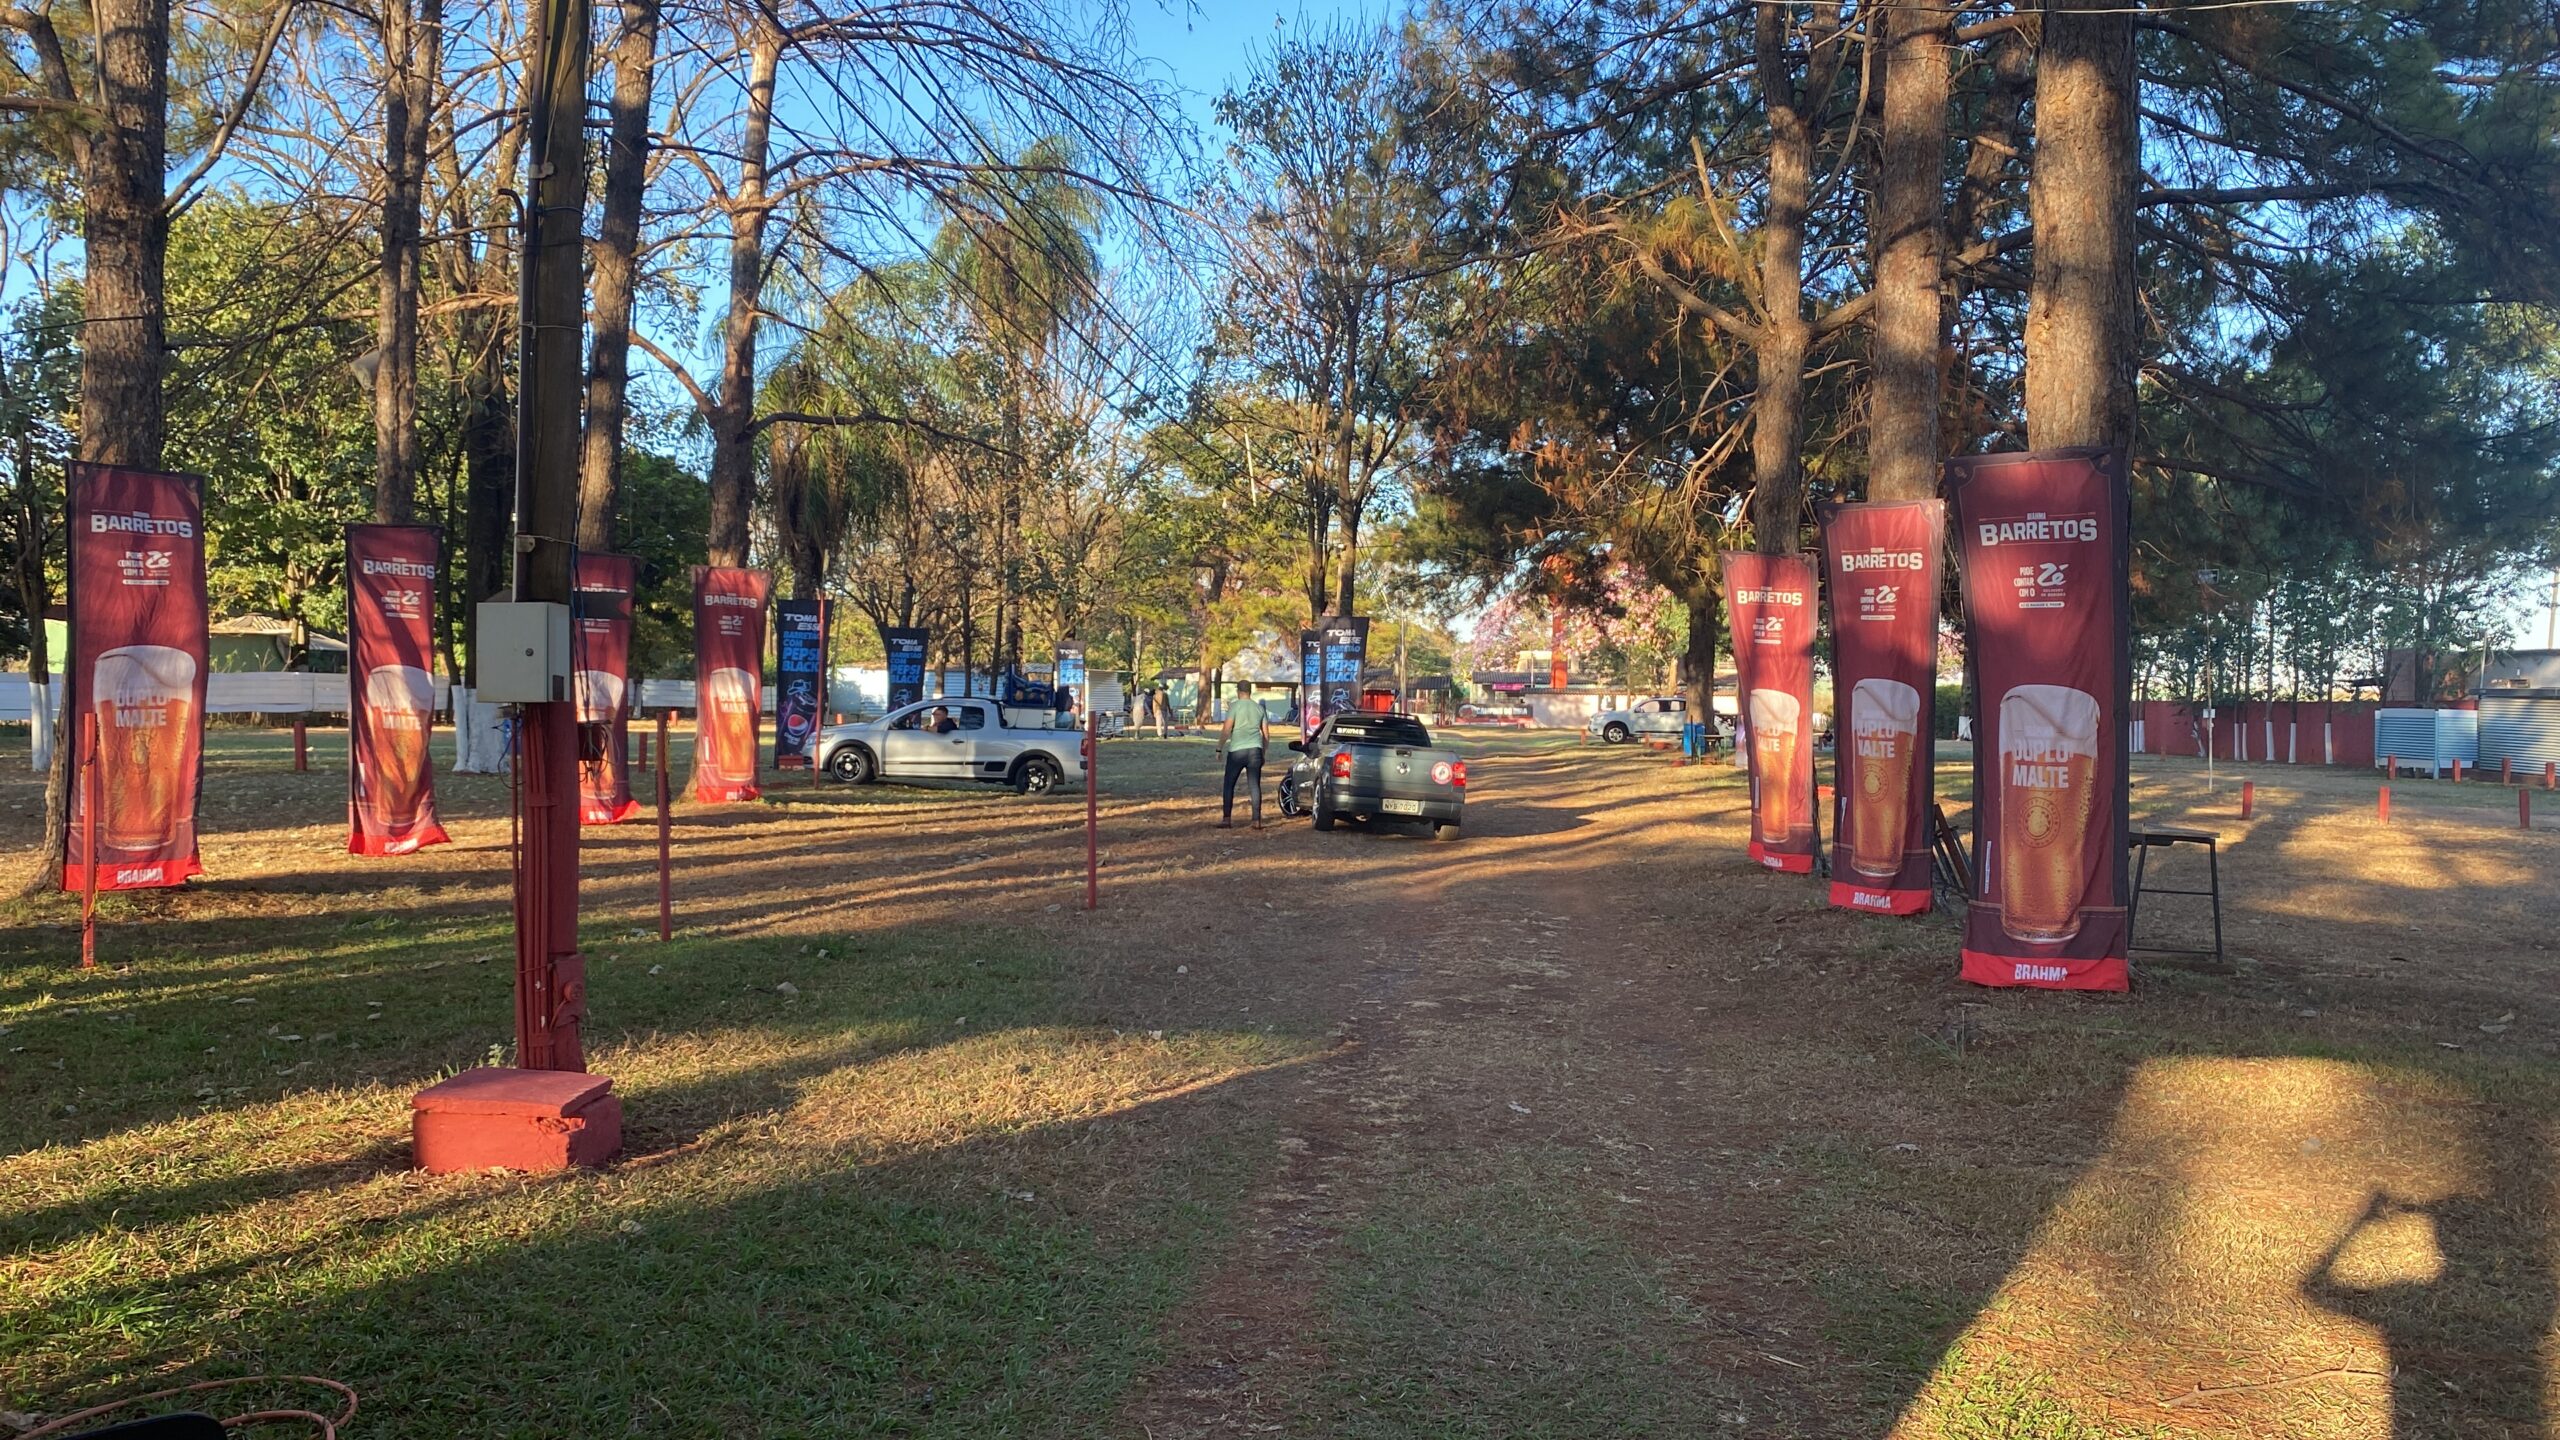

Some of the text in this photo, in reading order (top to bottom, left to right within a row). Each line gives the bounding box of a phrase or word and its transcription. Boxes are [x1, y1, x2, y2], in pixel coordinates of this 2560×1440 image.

[91, 514, 193, 538] BARRETOS
[1979, 519, 2098, 546] BARRETOS
[1841, 552, 1923, 572] BARRETOS
[363, 560, 436, 579] BARRETOS
[2019, 566, 2035, 576] PODE
[2037, 562, 2069, 587] Zé
[2013, 577, 2035, 587] CONTAR
[704, 594, 758, 609] BARRETOS
[1737, 590, 1803, 606] BARRETOS
[783, 613, 818, 622] TOMA
[1326, 629, 1356, 637] TOMA
[783, 639, 803, 647] COM
[1326, 652, 1344, 660] COM
[782, 660, 820, 672] BLACK
[890, 664, 921, 675] PEPSI
[1326, 660, 1359, 672] PEPSI
[890, 674, 920, 684] BLACK
[1325, 671, 1357, 683] BLACK
[115, 709, 167, 728] MALTE
[2012, 738, 2068, 762] DUPLO
[2012, 764, 2069, 788] MALTE
